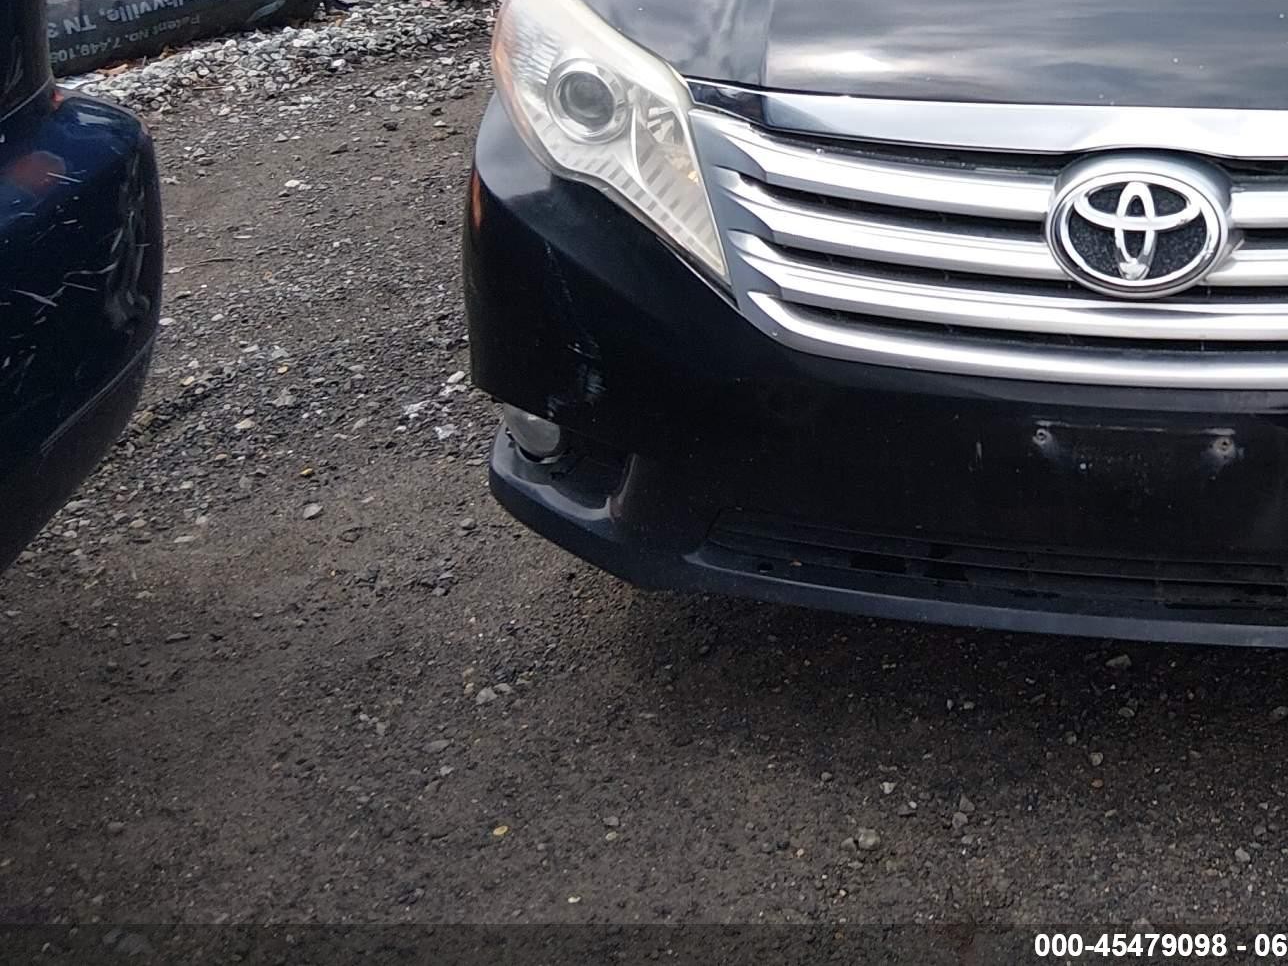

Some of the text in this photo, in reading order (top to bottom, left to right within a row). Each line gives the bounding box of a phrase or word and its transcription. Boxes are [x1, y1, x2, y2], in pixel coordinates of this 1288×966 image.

[63, 14, 97, 35] TN
[154, 14, 200, 34] Patent
[125, 28, 149, 41] No.
